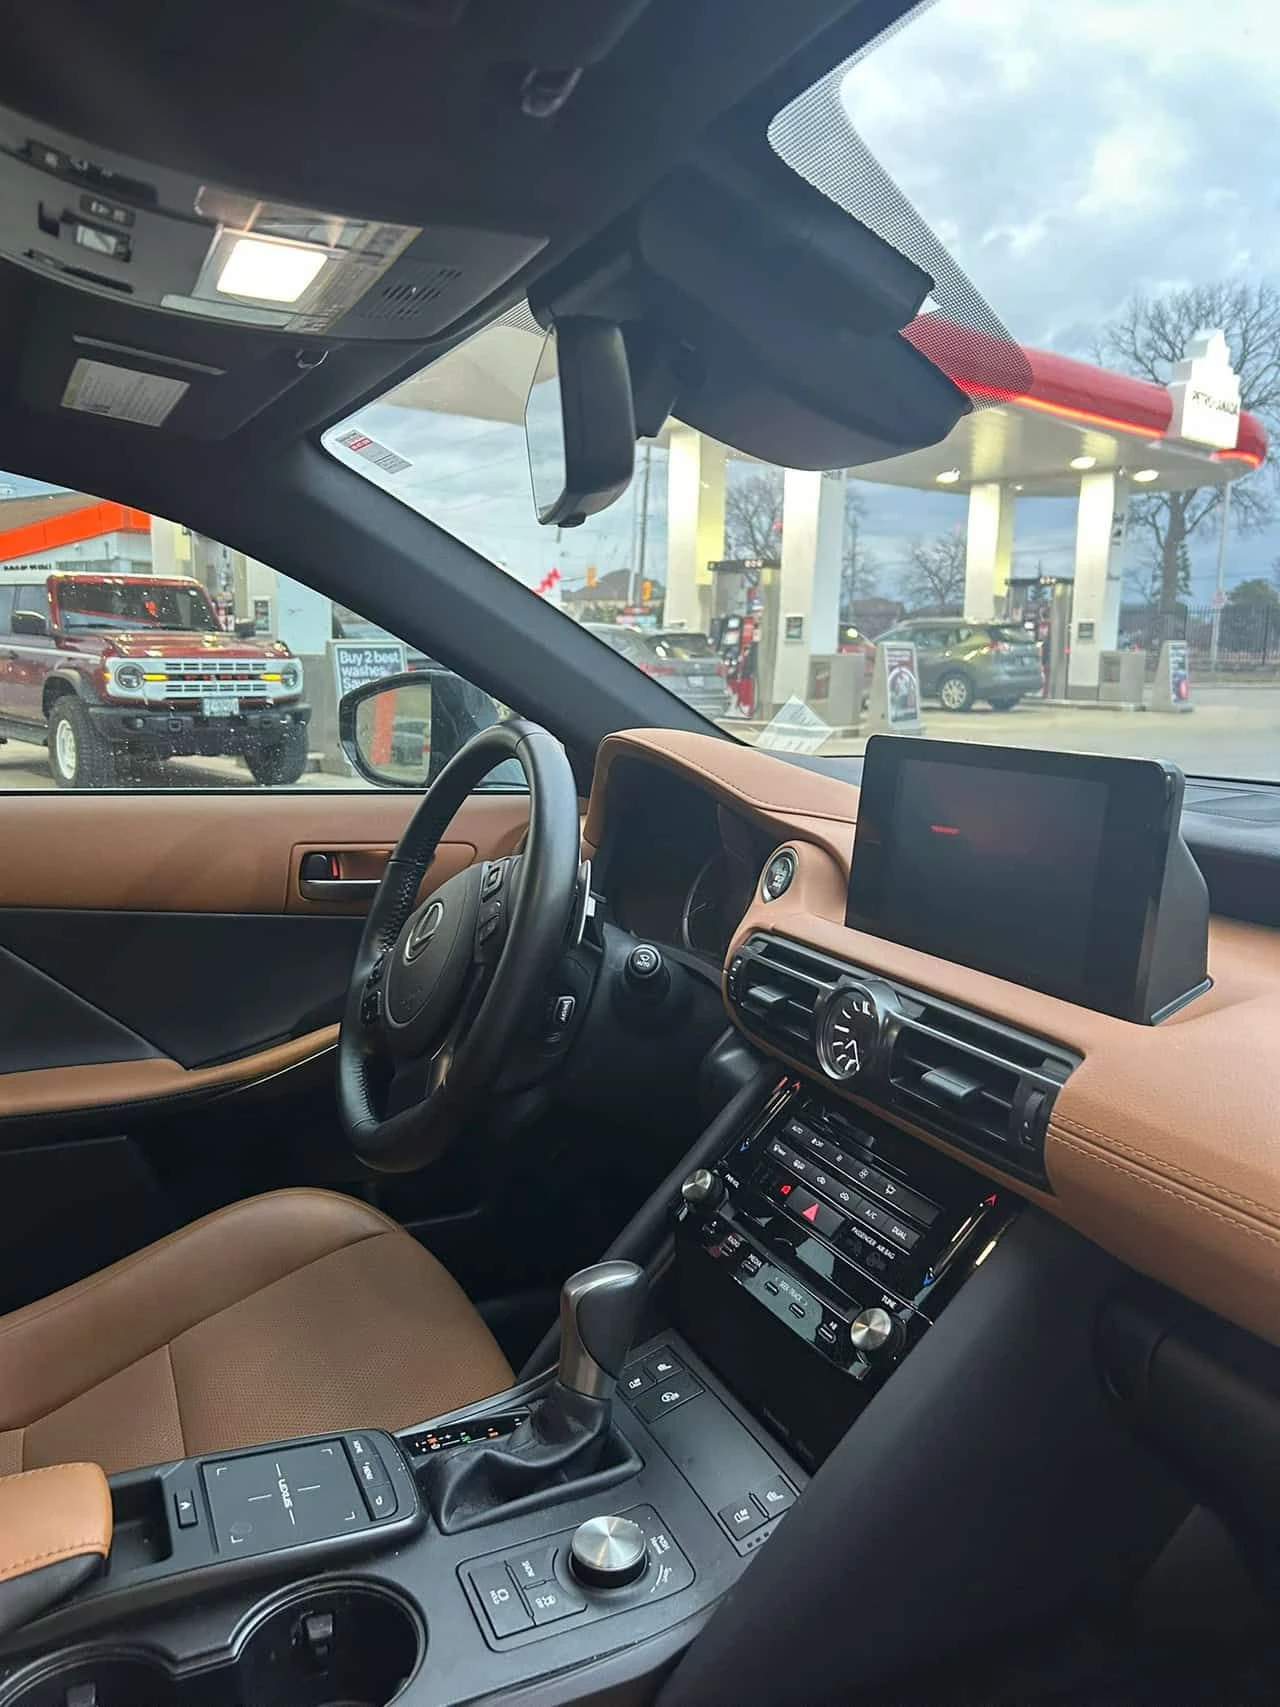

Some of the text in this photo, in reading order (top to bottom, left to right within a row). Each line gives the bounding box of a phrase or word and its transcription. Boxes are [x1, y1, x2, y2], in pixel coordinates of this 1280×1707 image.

[340, 650, 399, 666] Buy 2 best
[343, 678, 368, 690] Sav
[865, 1209, 878, 1220] A/C
[851, 1226, 877, 1246] PASSENGER
[891, 1225, 908, 1241] DUAL
[881, 1294, 897, 1309] TUNE
[278, 1478, 294, 1509] LEXUS
